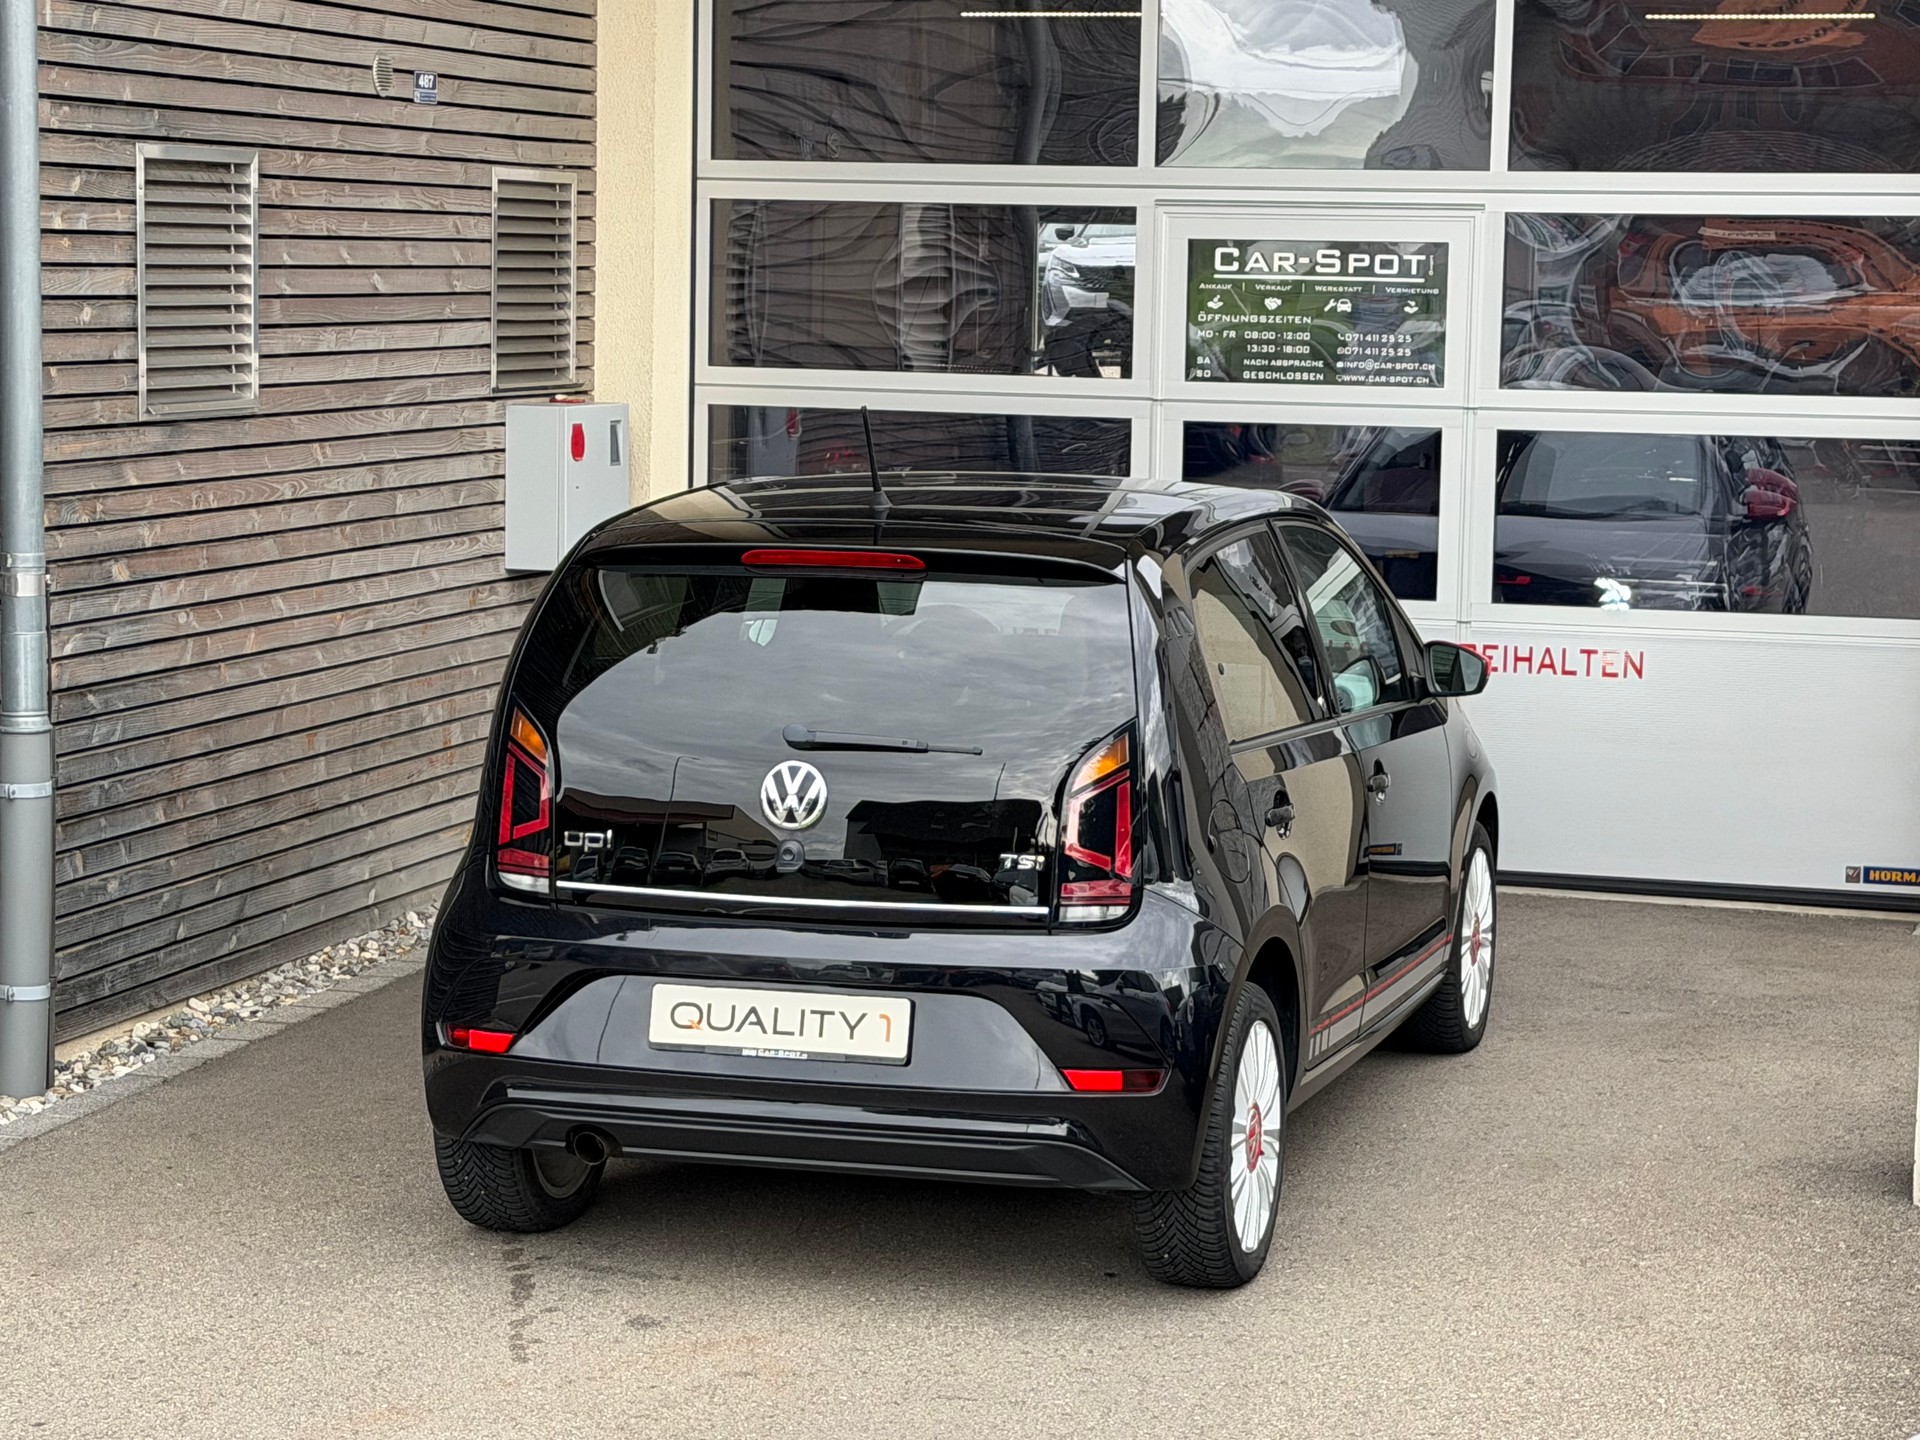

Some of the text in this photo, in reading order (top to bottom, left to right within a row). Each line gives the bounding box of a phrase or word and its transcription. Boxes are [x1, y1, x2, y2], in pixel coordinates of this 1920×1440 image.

[1214, 247, 1426, 275] CAR-SPOT
[1199, 282, 1233, 290] ANKAUF
[1255, 283, 1292, 291] VERKAUF
[1314, 285, 1362, 293] WERKSTATT
[1385, 287, 1439, 295] VERMIETUNG
[1198, 311, 1312, 324] ÖFFNUNGSZEITEN
[1223, 330, 1237, 338] FR
[1244, 331, 1276, 340] 08:00
[1283, 332, 1311, 340] 12:00
[1247, 344, 1275, 352] 13:30
[1196, 356, 1211, 364] SA
[1270, 359, 1324, 368] ABSPRACHE
[1243, 371, 1324, 381] GESCHLOSSEN
[670, 1001, 868, 1040] QUALITY
